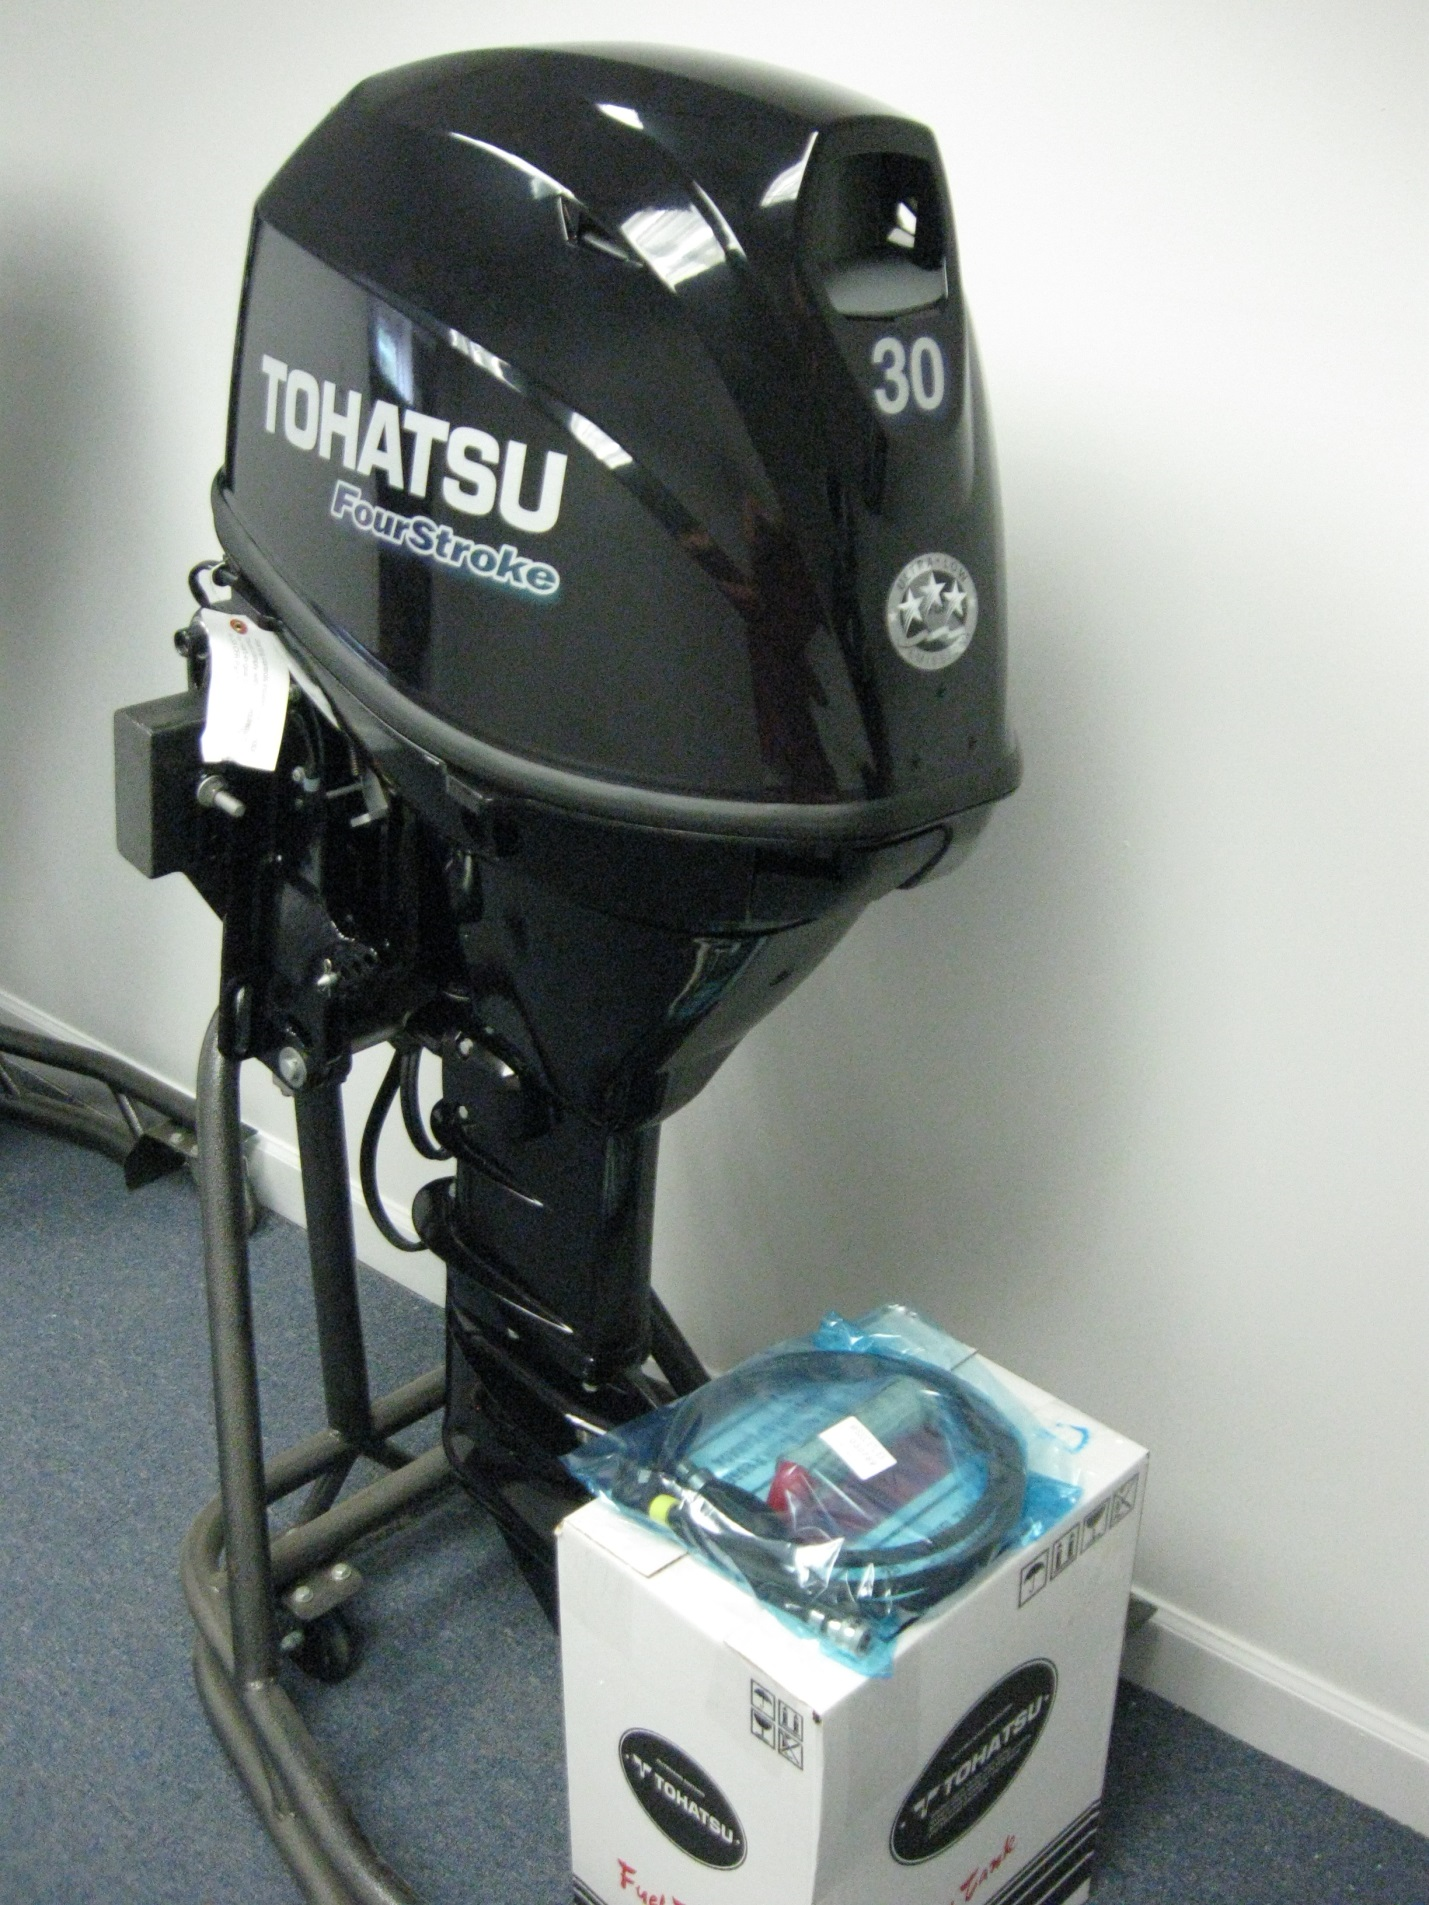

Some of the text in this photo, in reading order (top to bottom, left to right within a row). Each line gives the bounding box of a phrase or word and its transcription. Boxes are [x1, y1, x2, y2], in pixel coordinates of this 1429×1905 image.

[872, 336, 945, 415] 30
[261, 353, 568, 534] TOHATSU
[330, 479, 561, 595] FourStroke
[942, 1693, 1043, 1796] TOHATSU
[653, 1772, 735, 1844] TOHATSU
